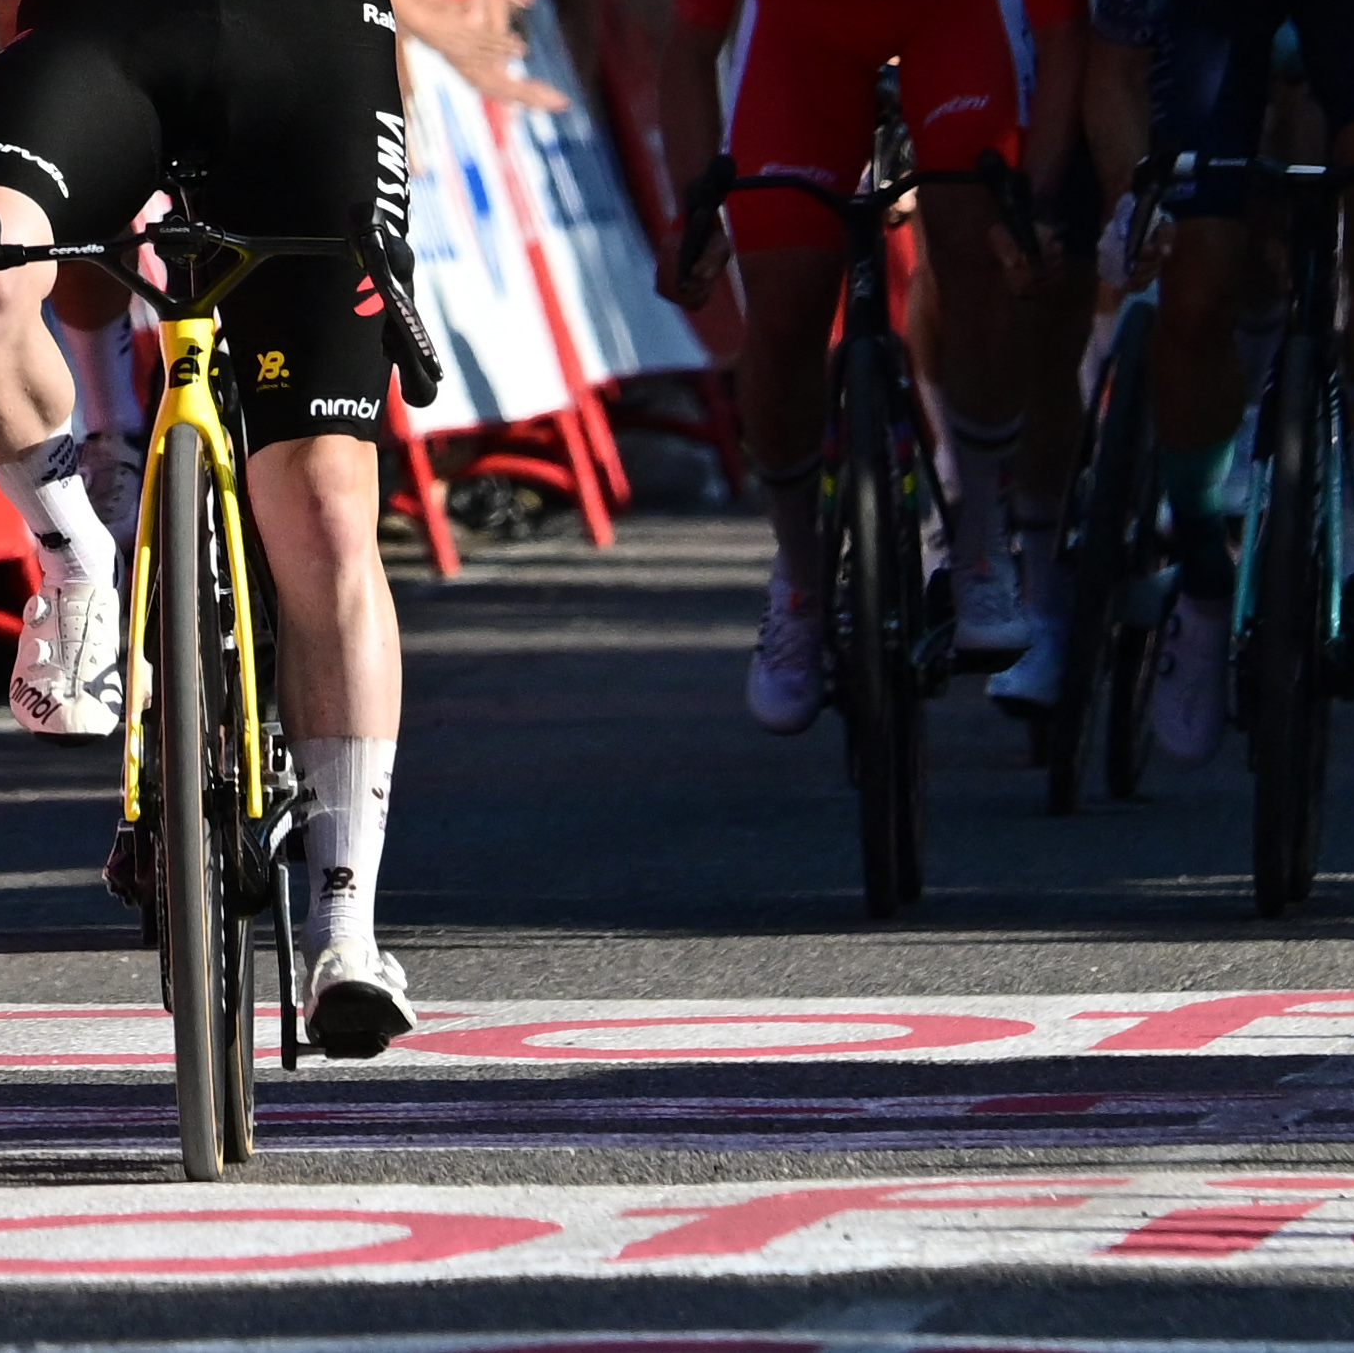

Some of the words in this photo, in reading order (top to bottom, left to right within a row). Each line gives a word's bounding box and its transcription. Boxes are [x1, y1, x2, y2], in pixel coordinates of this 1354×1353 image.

[48, 243, 105, 257] cervélo
[309, 396, 381, 421] nimbl
[10, 676, 63, 726] nimbl
